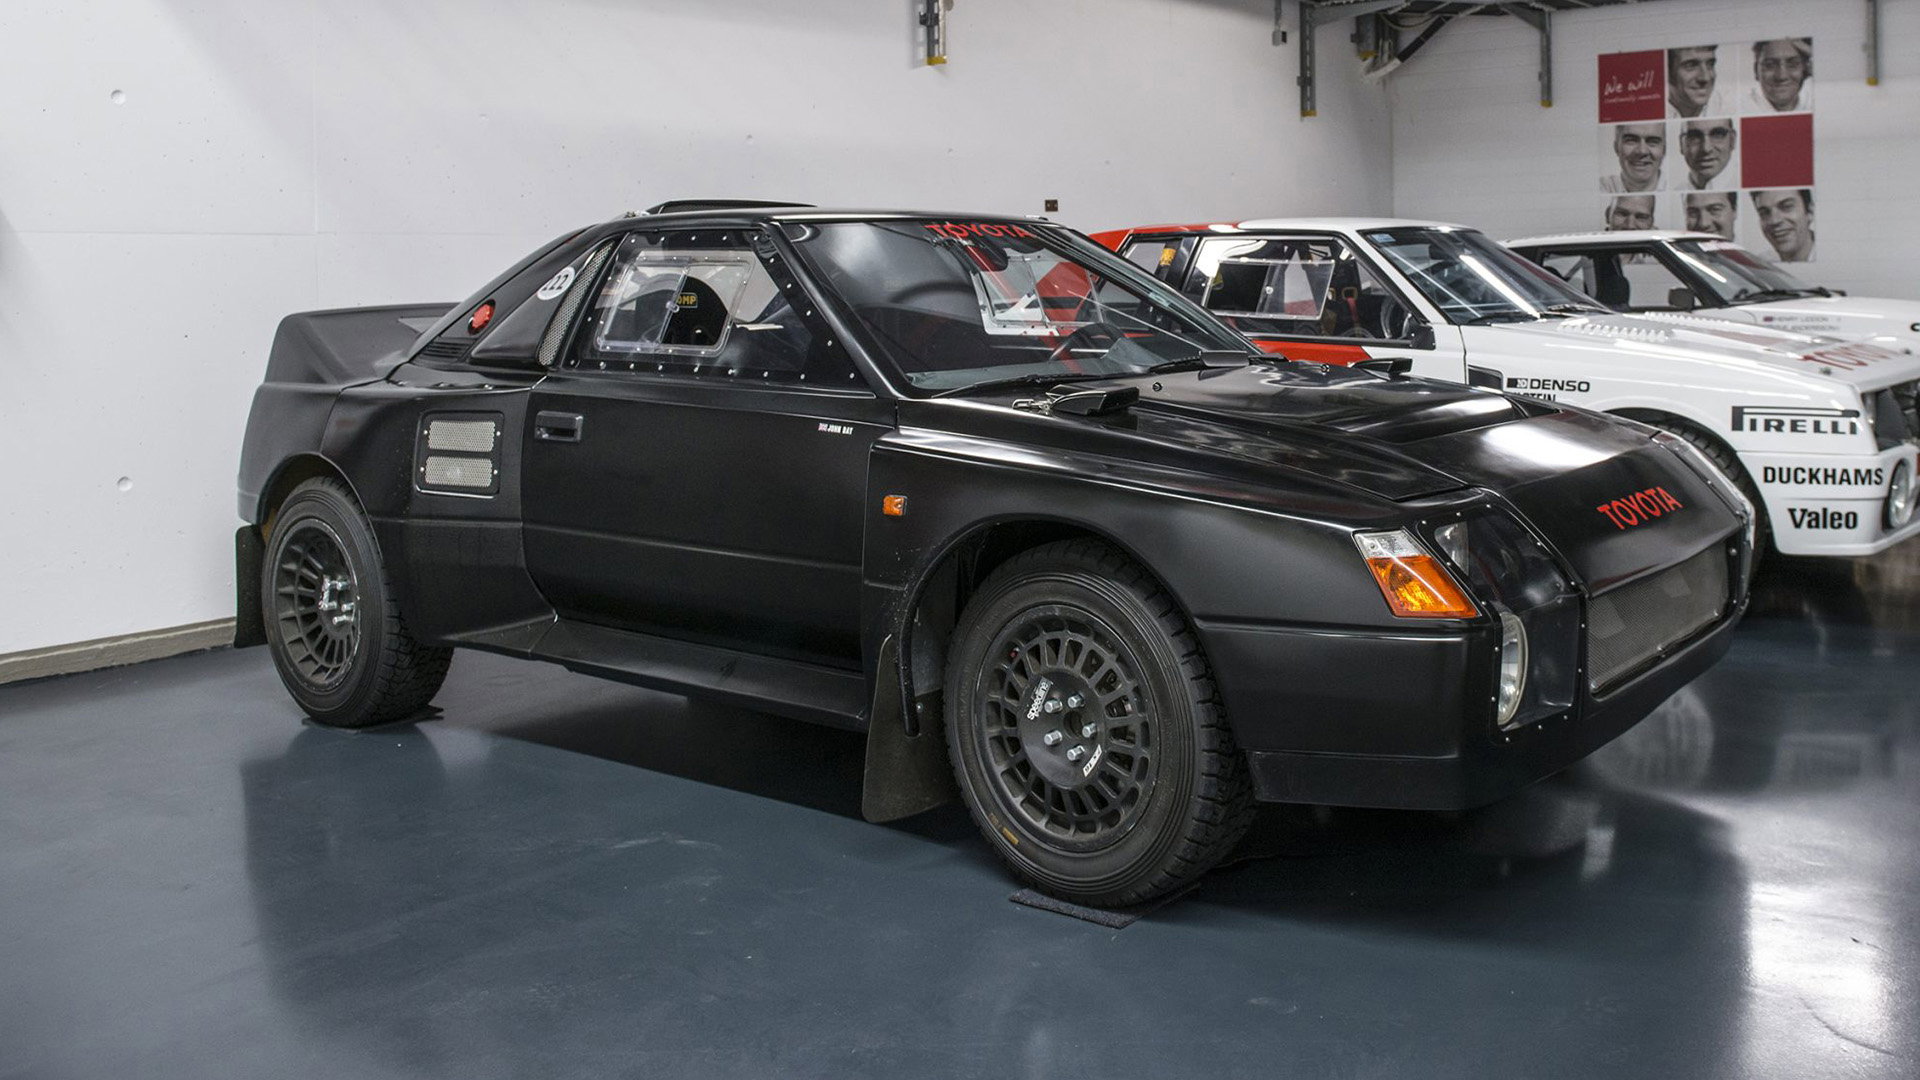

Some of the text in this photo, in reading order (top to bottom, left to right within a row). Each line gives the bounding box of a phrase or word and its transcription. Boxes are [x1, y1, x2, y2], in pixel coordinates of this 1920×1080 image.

[1627, 70, 1655, 91] will
[923, 222, 1038, 239] TOYOTA
[1529, 378, 1591, 392] DENSO
[1731, 406, 1861, 435] PIRELLI
[1763, 466, 1884, 486] DUCKHAMS
[1596, 486, 1683, 530] TOYOTA
[1787, 507, 1858, 530] Valeo
